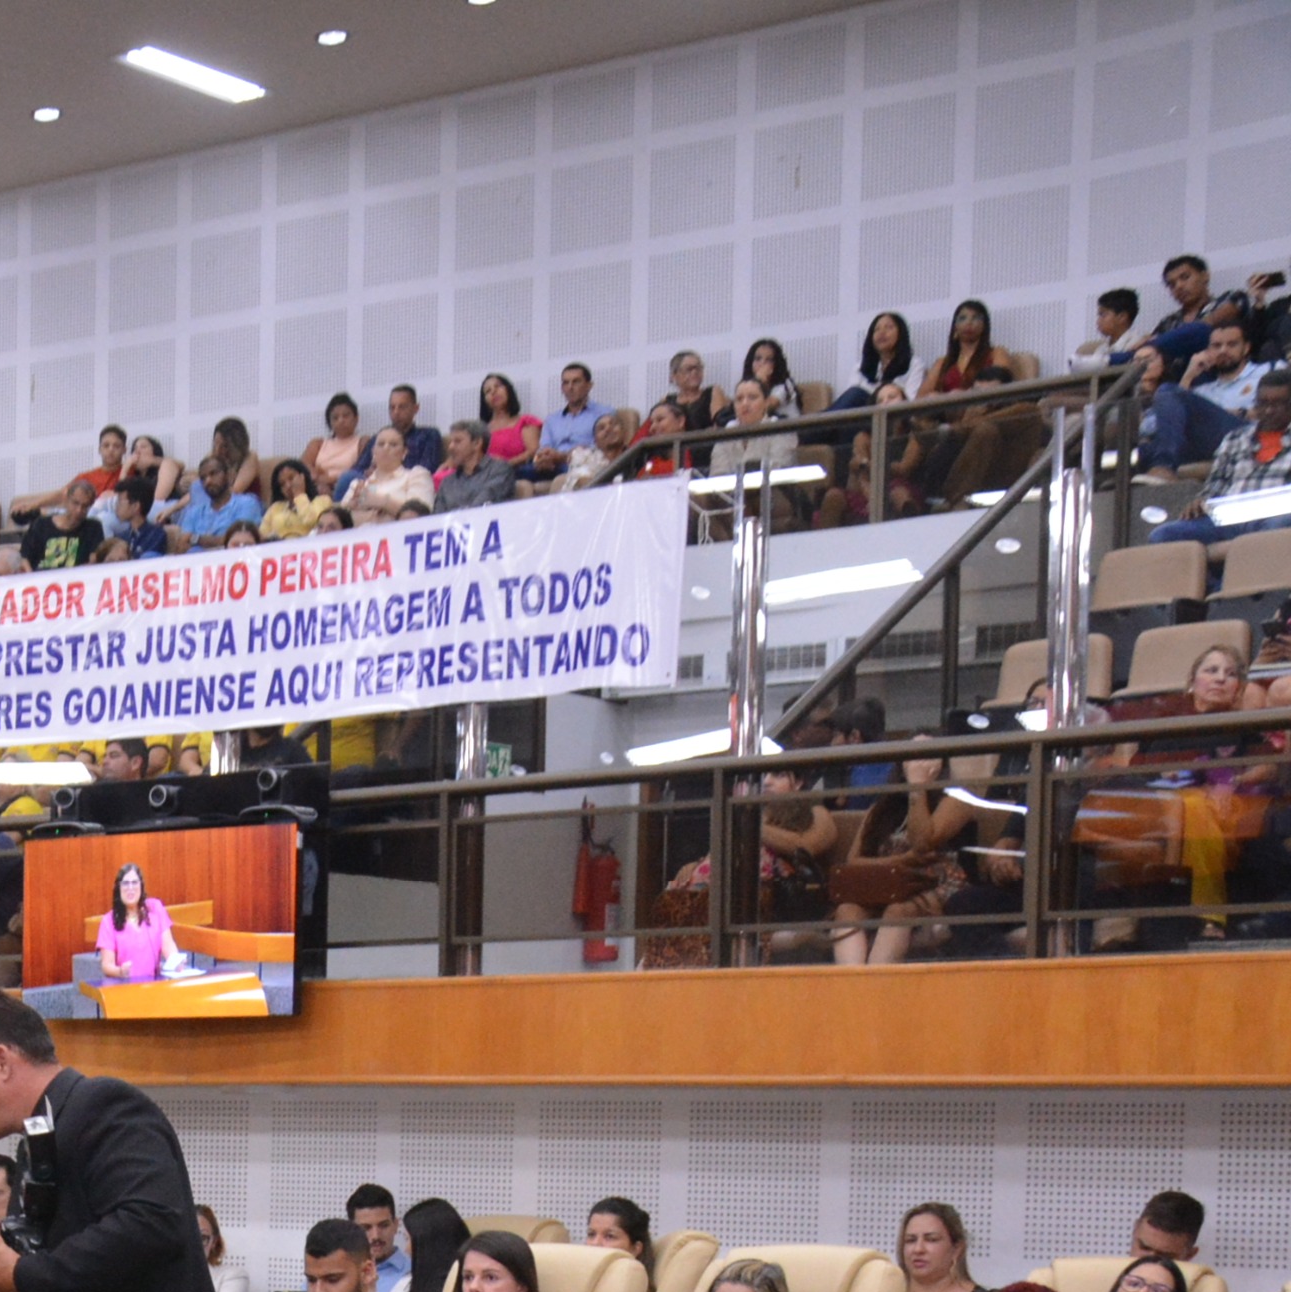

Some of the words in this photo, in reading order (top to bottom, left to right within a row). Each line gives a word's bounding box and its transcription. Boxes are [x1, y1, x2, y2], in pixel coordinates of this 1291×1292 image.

[95, 561, 249, 615] ANSELMO
[259, 538, 392, 596] PEREIRA
[404, 523, 471, 573] TEM
[479, 519, 503, 562] A
[136, 618, 236, 665] JUSTA
[248, 586, 452, 654] HOMENAGEM
[460, 581, 485, 624] A
[498, 562, 612, 619] TODOS
[63, 671, 256, 726] GOIANIENSE
[265, 659, 343, 708] AQUI
[354, 622, 650, 697] REPRESENTANDO
